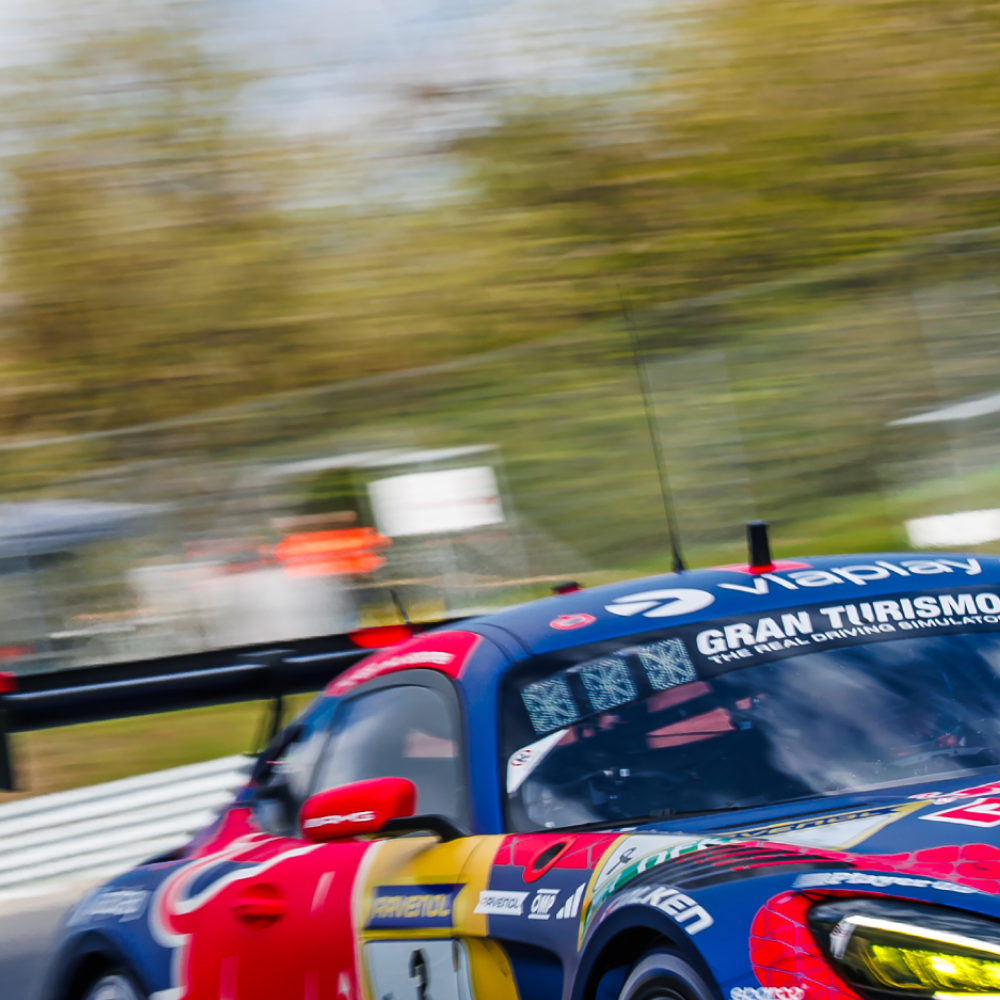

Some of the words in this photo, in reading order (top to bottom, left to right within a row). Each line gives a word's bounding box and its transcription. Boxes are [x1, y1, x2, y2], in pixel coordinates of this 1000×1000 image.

[717, 558, 982, 595] viaplay
[696, 611, 814, 656] GRAN
[708, 648, 753, 664] THE
[755, 637, 810, 655] REAL
[810, 622, 897, 643] DRIVING
